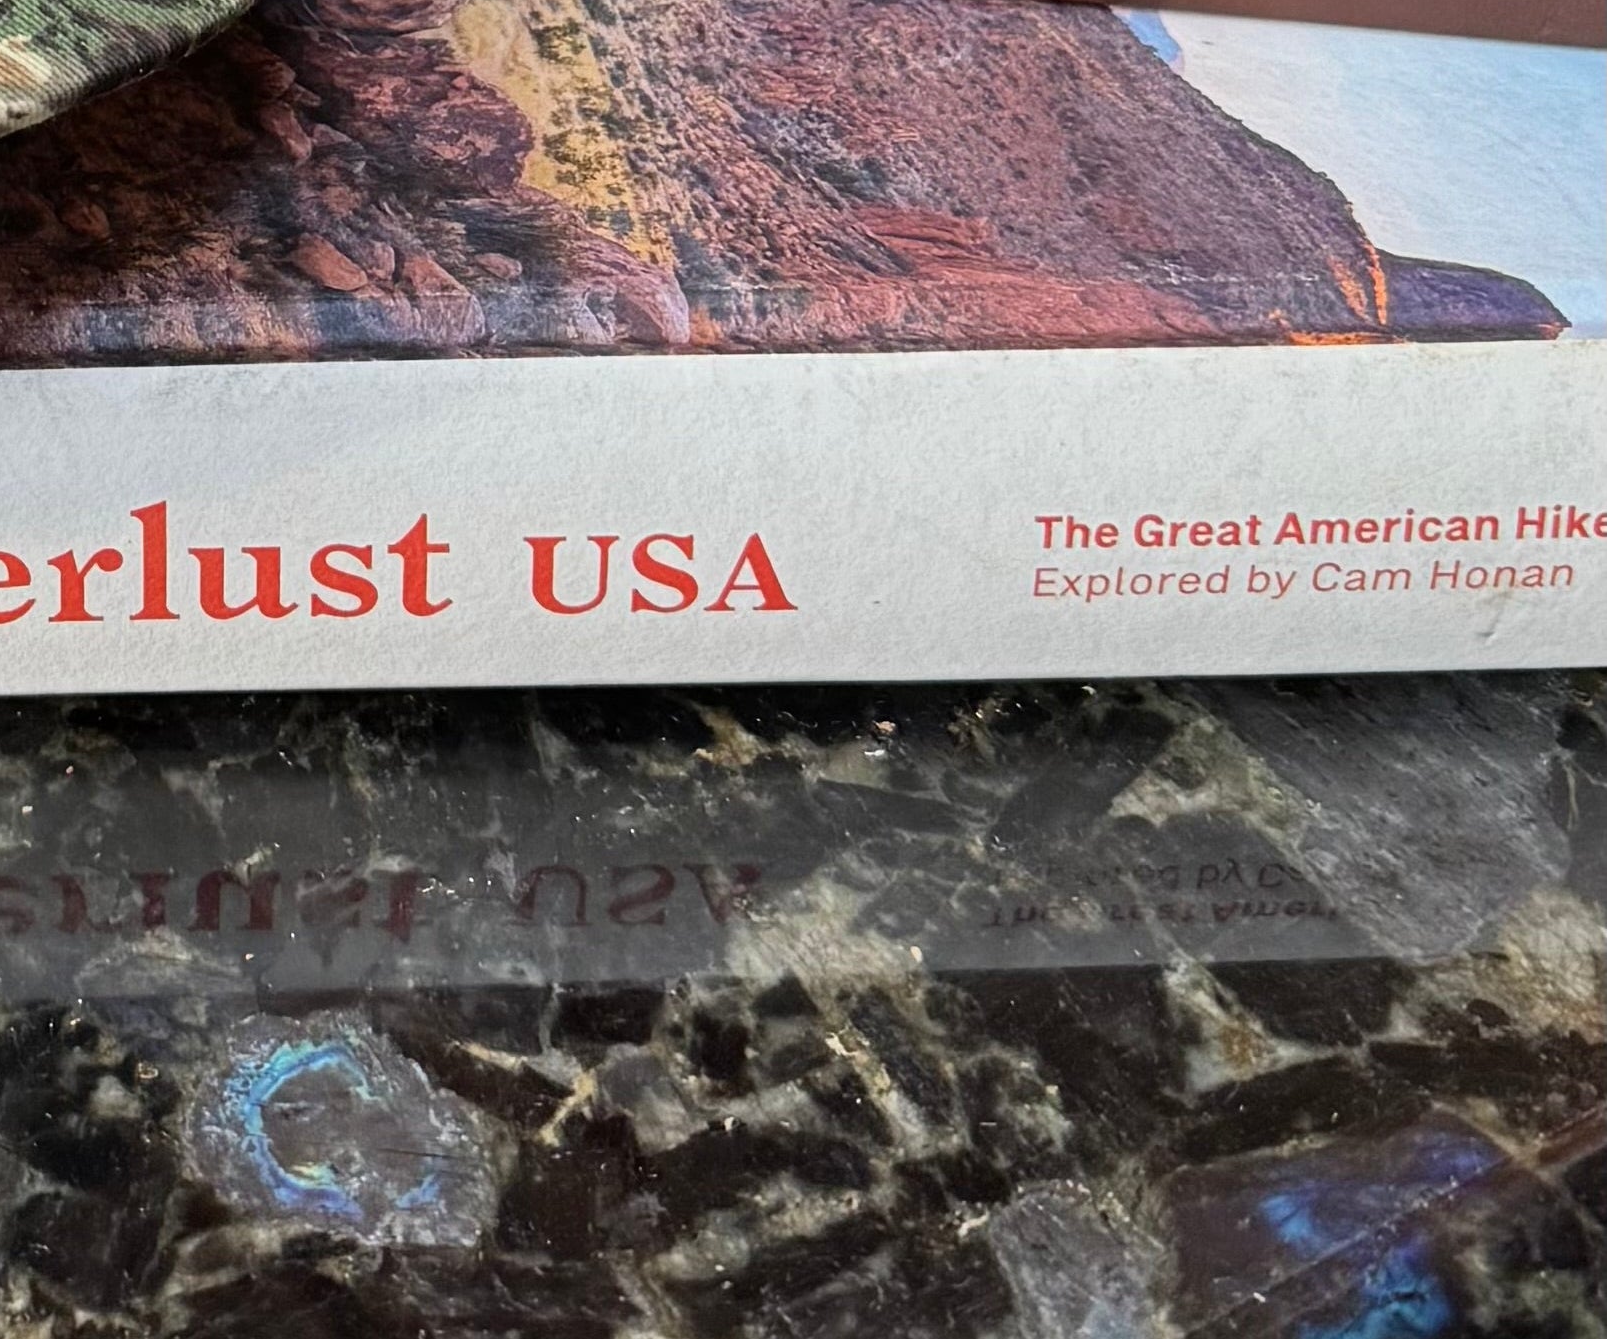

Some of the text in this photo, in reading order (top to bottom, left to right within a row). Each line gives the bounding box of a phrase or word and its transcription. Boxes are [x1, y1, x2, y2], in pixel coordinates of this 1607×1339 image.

[1034, 515, 1119, 549] The
[1134, 513, 1262, 547] Great
[1273, 509, 1501, 546] American
[523, 530, 799, 615] USA
[1032, 559, 1576, 604] Explored by Cam Honan
